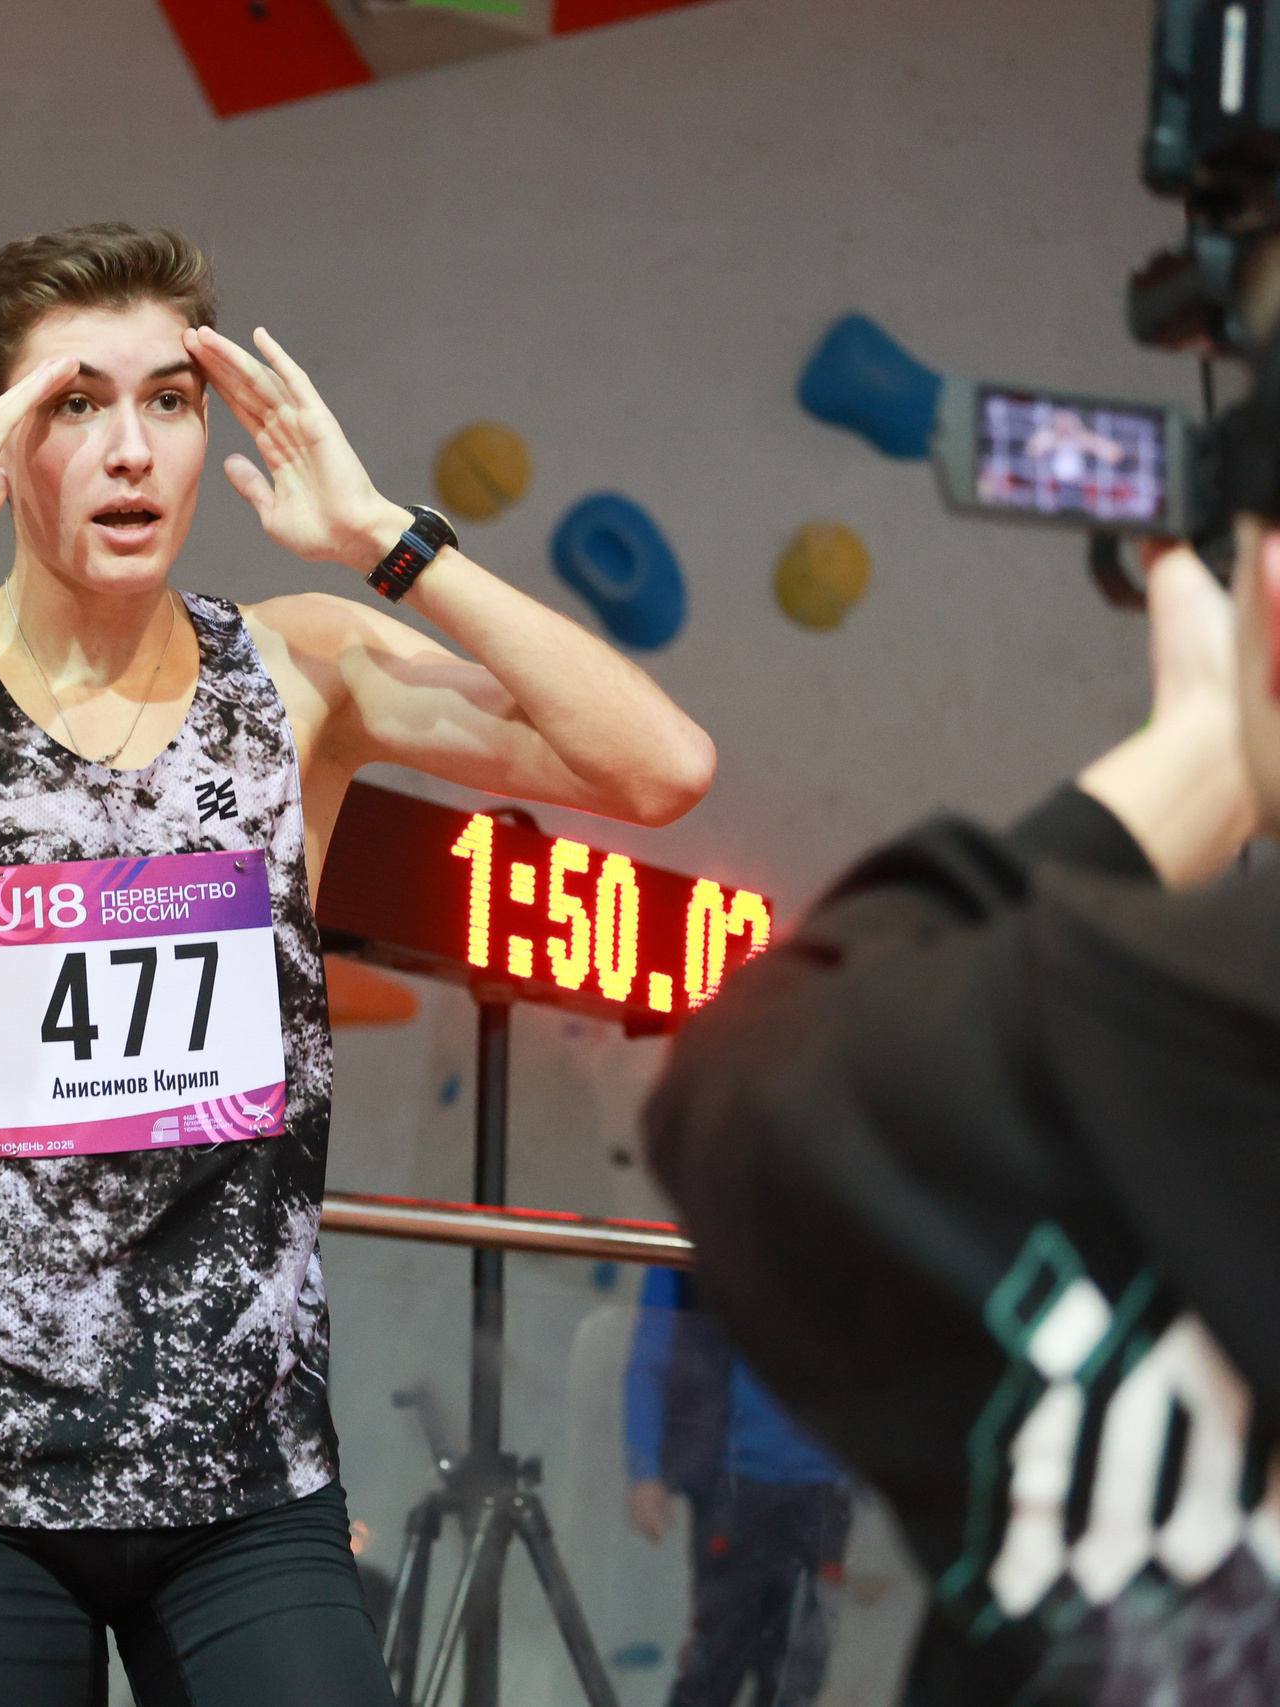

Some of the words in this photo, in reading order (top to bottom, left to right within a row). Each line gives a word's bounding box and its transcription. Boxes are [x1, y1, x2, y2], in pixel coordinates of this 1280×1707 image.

[100, 881, 237, 908] ПЕРВЕНСТВО
[101, 902, 190, 926] РОССИИ
[41, 941, 219, 1061] 477
[52, 1077, 149, 1099] Анисимов
[153, 1069, 220, 1096] Кирилл
[47, 1140, 75, 1151] 2025
